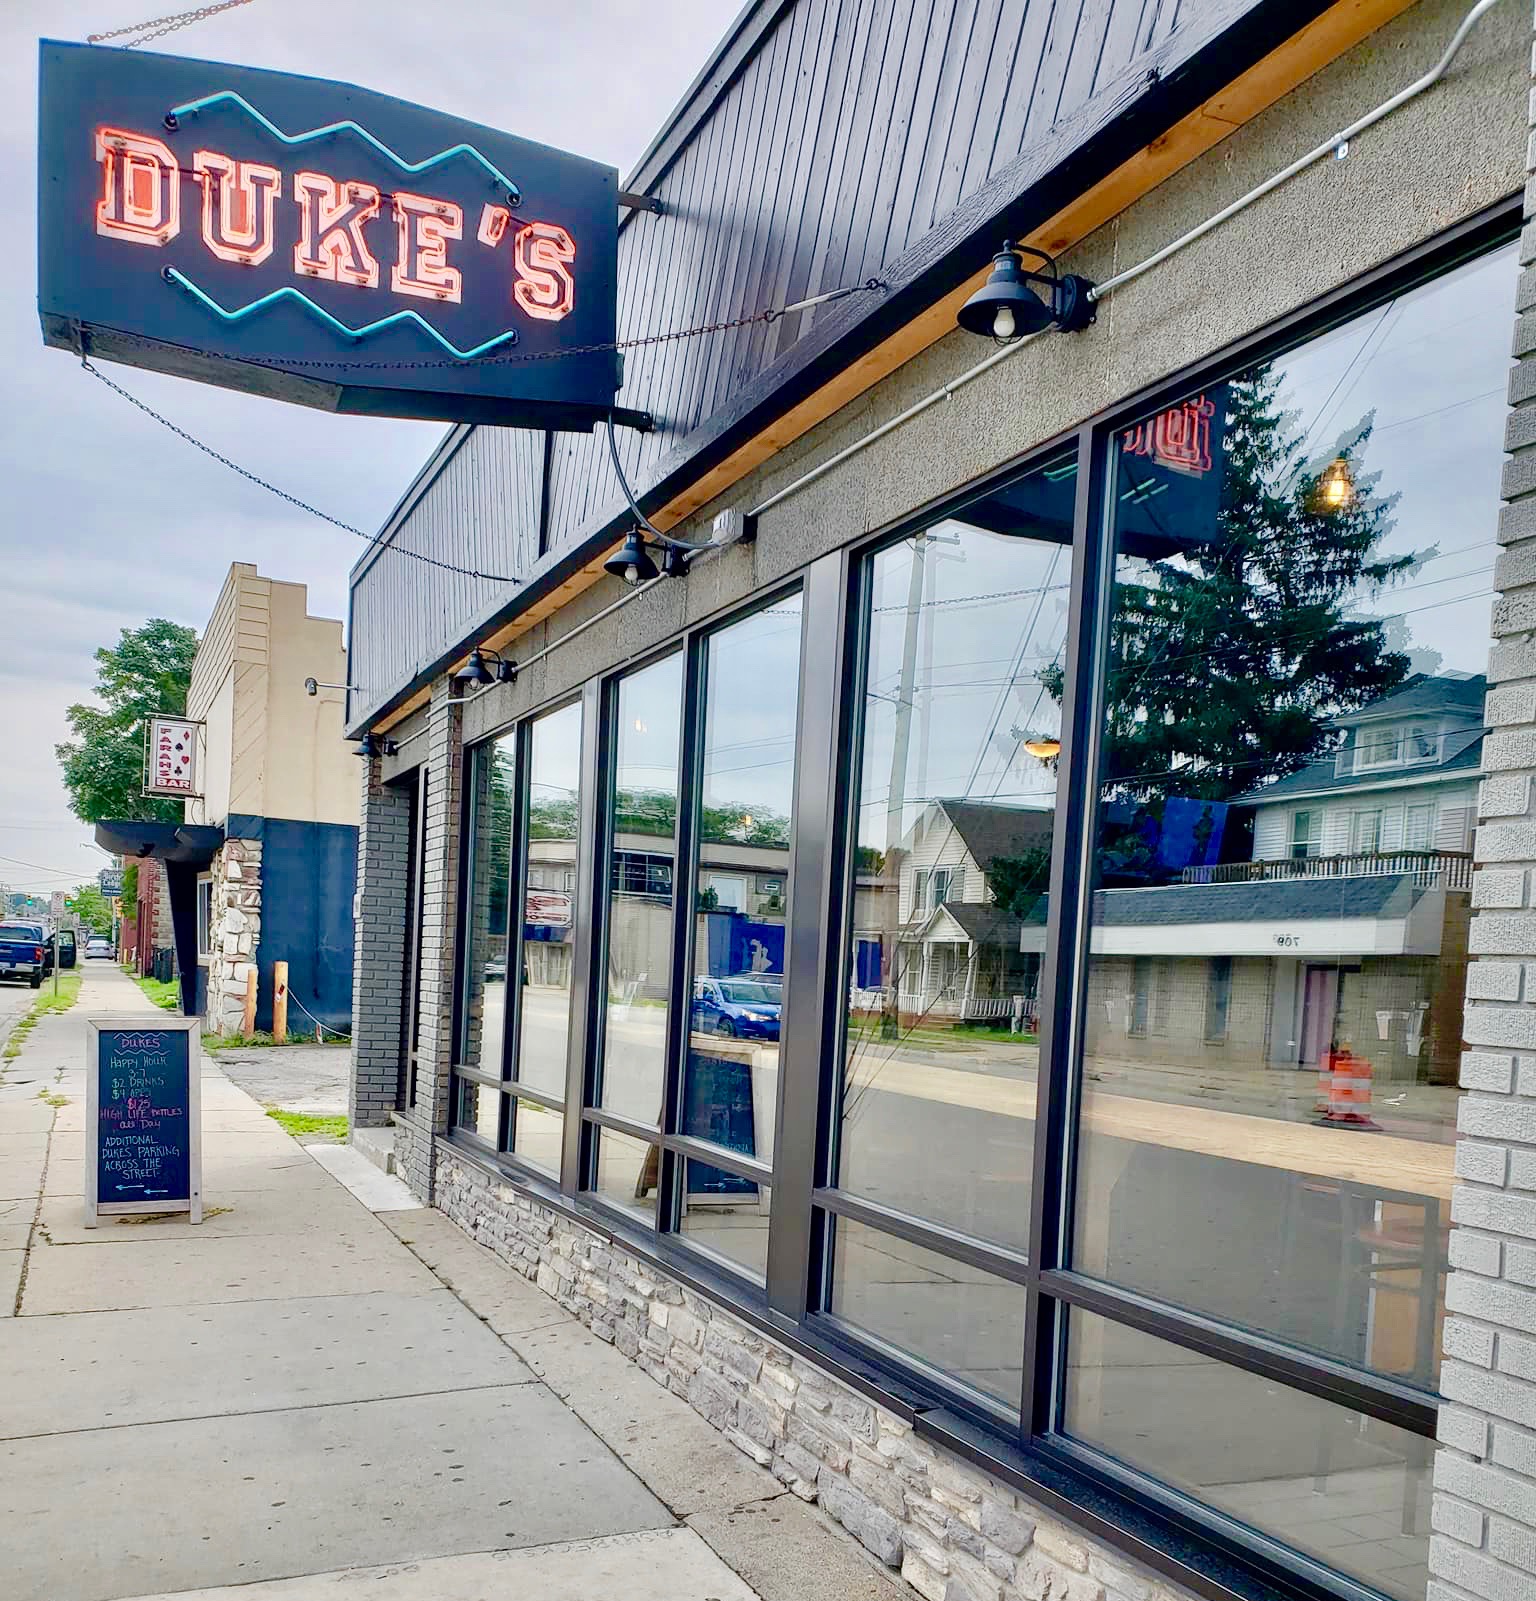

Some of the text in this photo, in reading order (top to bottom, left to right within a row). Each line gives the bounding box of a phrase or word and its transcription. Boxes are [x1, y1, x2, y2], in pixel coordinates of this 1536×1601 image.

[95, 127, 576, 322] DUKE'S
[157, 778, 190, 789] BAR
[121, 1038, 160, 1048] DUKES
[112, 1077, 165, 1089] $2 DRINKS
[112, 1088, 126, 1100] $4
[100, 1107, 123, 1120] HIGH
[127, 1108, 148, 1119] LIFE
[105, 1135, 160, 1147] ADDITIONAL
[102, 1145, 180, 1159] DUKES PARKING
[105, 1157, 161, 1171] ACROSS THE
